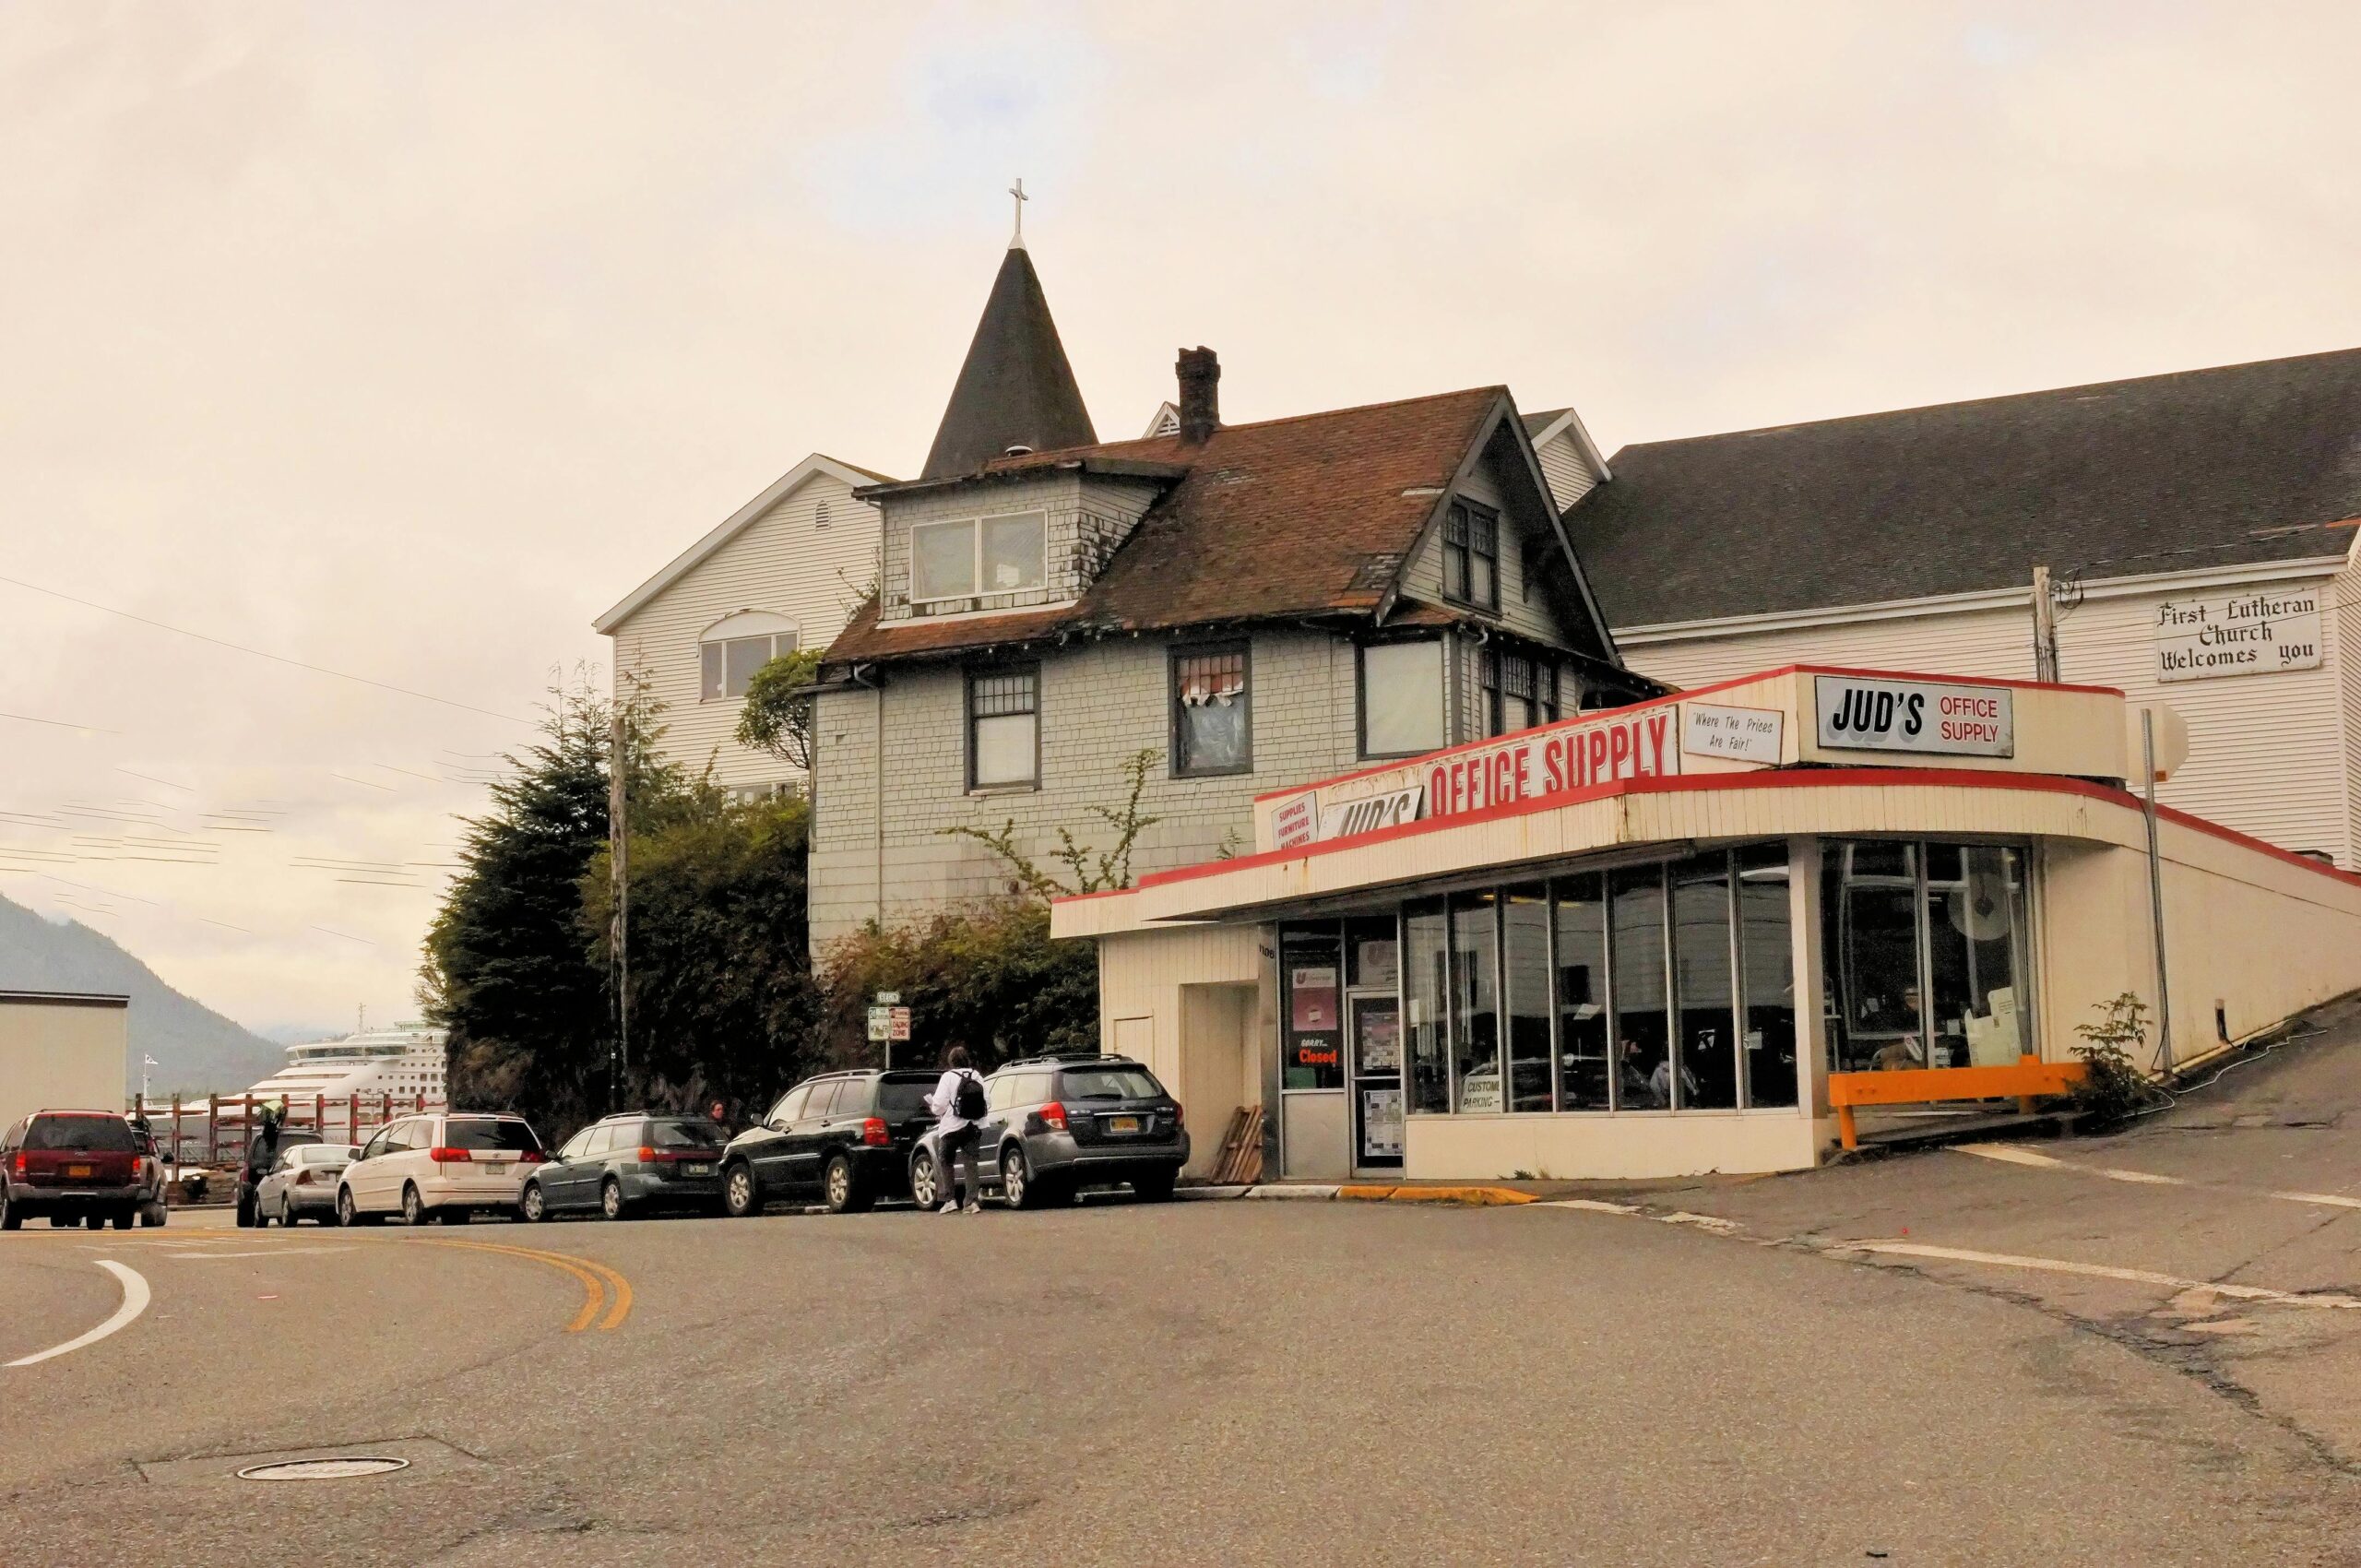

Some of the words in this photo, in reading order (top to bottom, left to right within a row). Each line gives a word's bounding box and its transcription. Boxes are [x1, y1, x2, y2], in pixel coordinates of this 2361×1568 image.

[2156, 601, 2206, 628] First
[2226, 596, 2315, 621] Lutheran
[2199, 620, 2273, 647] Church
[2160, 647, 2259, 671] Welcomes
[2278, 643, 2315, 669] you
[1832, 688, 1925, 736] JUD'S
[1940, 695, 1999, 719] OFFICE
[1725, 716, 1740, 731] The
[1746, 718, 1774, 734] Prices
[1940, 720, 1999, 743] SUPPLY
[1709, 734, 1723, 748] Are
[1430, 745, 1531, 816] OFFICE
[1544, 713, 1668, 795] SUPPLY
[1278, 802, 1306, 823] SUPPLIES
[1277, 816, 1310, 839] FURNITURE
[1280, 832, 1311, 849] MACHINES
[1299, 1048, 1337, 1063] Closed
[1463, 1096, 1493, 1109] PARKING
